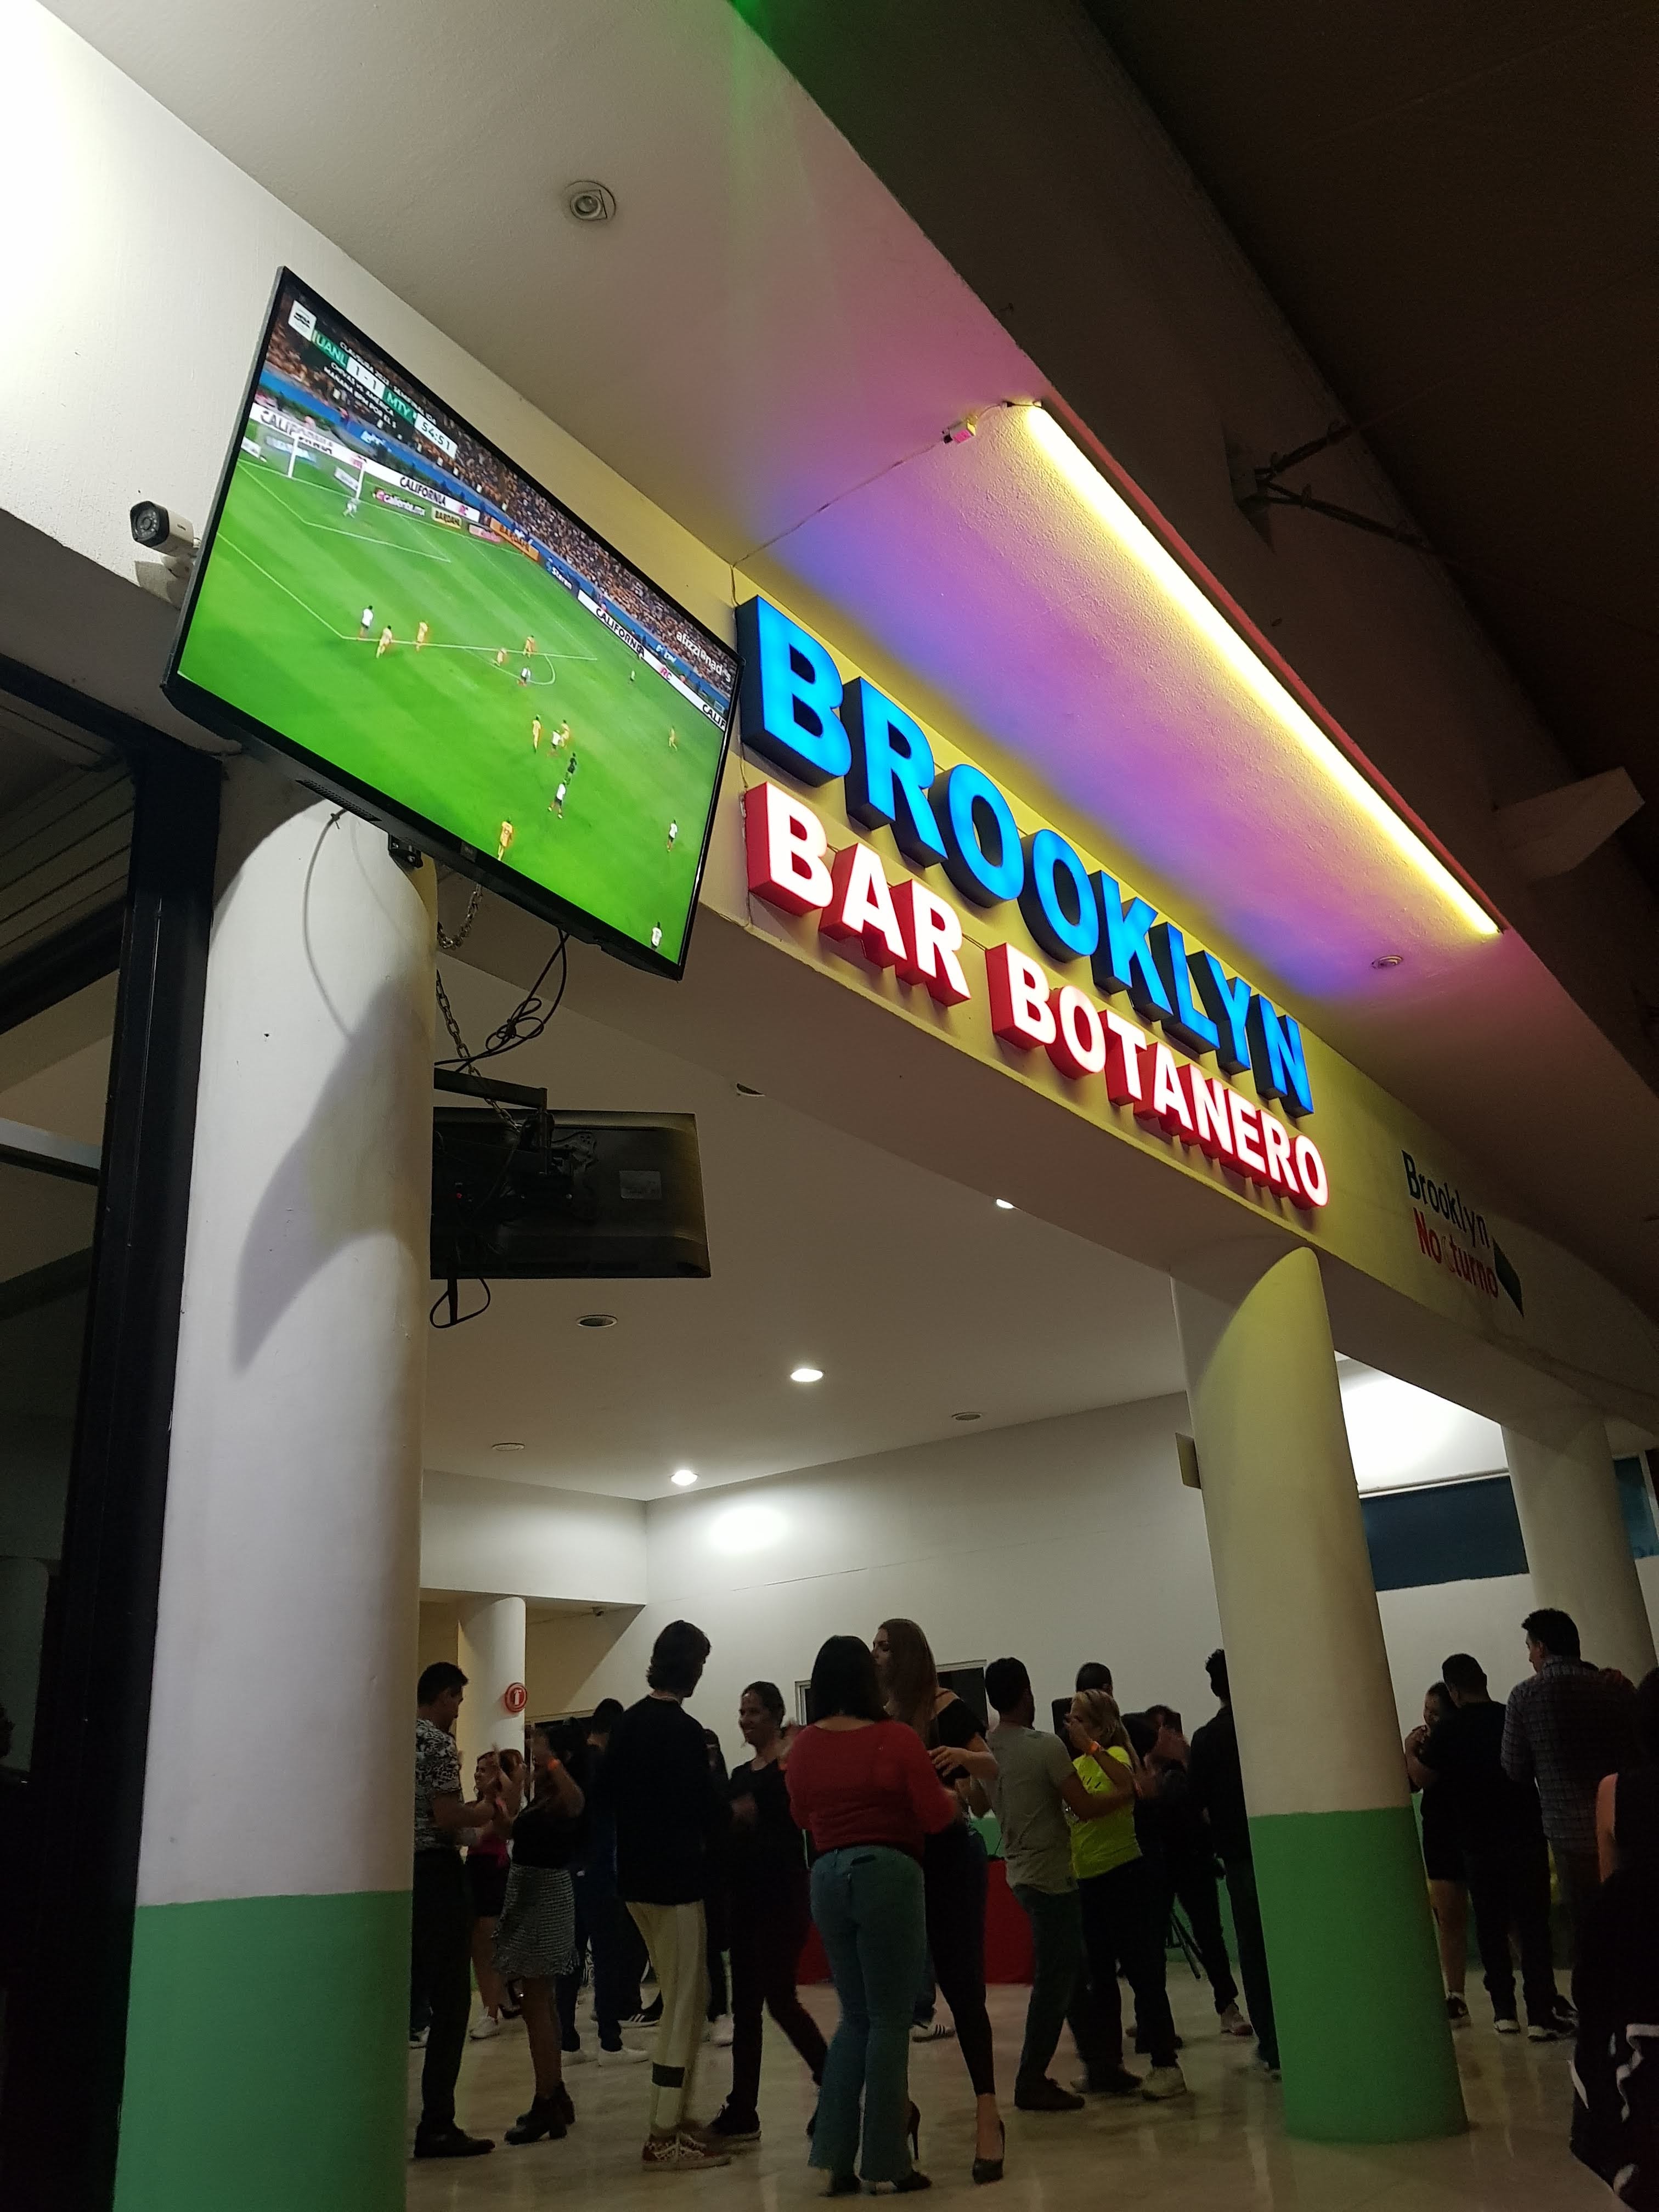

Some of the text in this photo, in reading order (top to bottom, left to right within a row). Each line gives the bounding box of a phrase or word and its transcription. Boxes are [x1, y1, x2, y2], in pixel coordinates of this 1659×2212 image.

[316, 333, 347, 368] UANL
[387, 391, 411, 416] MTY
[421, 421, 450, 450] 54:51
[399, 476, 446, 507] CALIFORNIA
[596, 607, 645, 658] CALIFORNIA
[754, 595, 1315, 1117] BROOKLYN
[766, 781, 1330, 1208] BAR BOTANERO
[1401, 1149, 1491, 1249] Brooklyn
